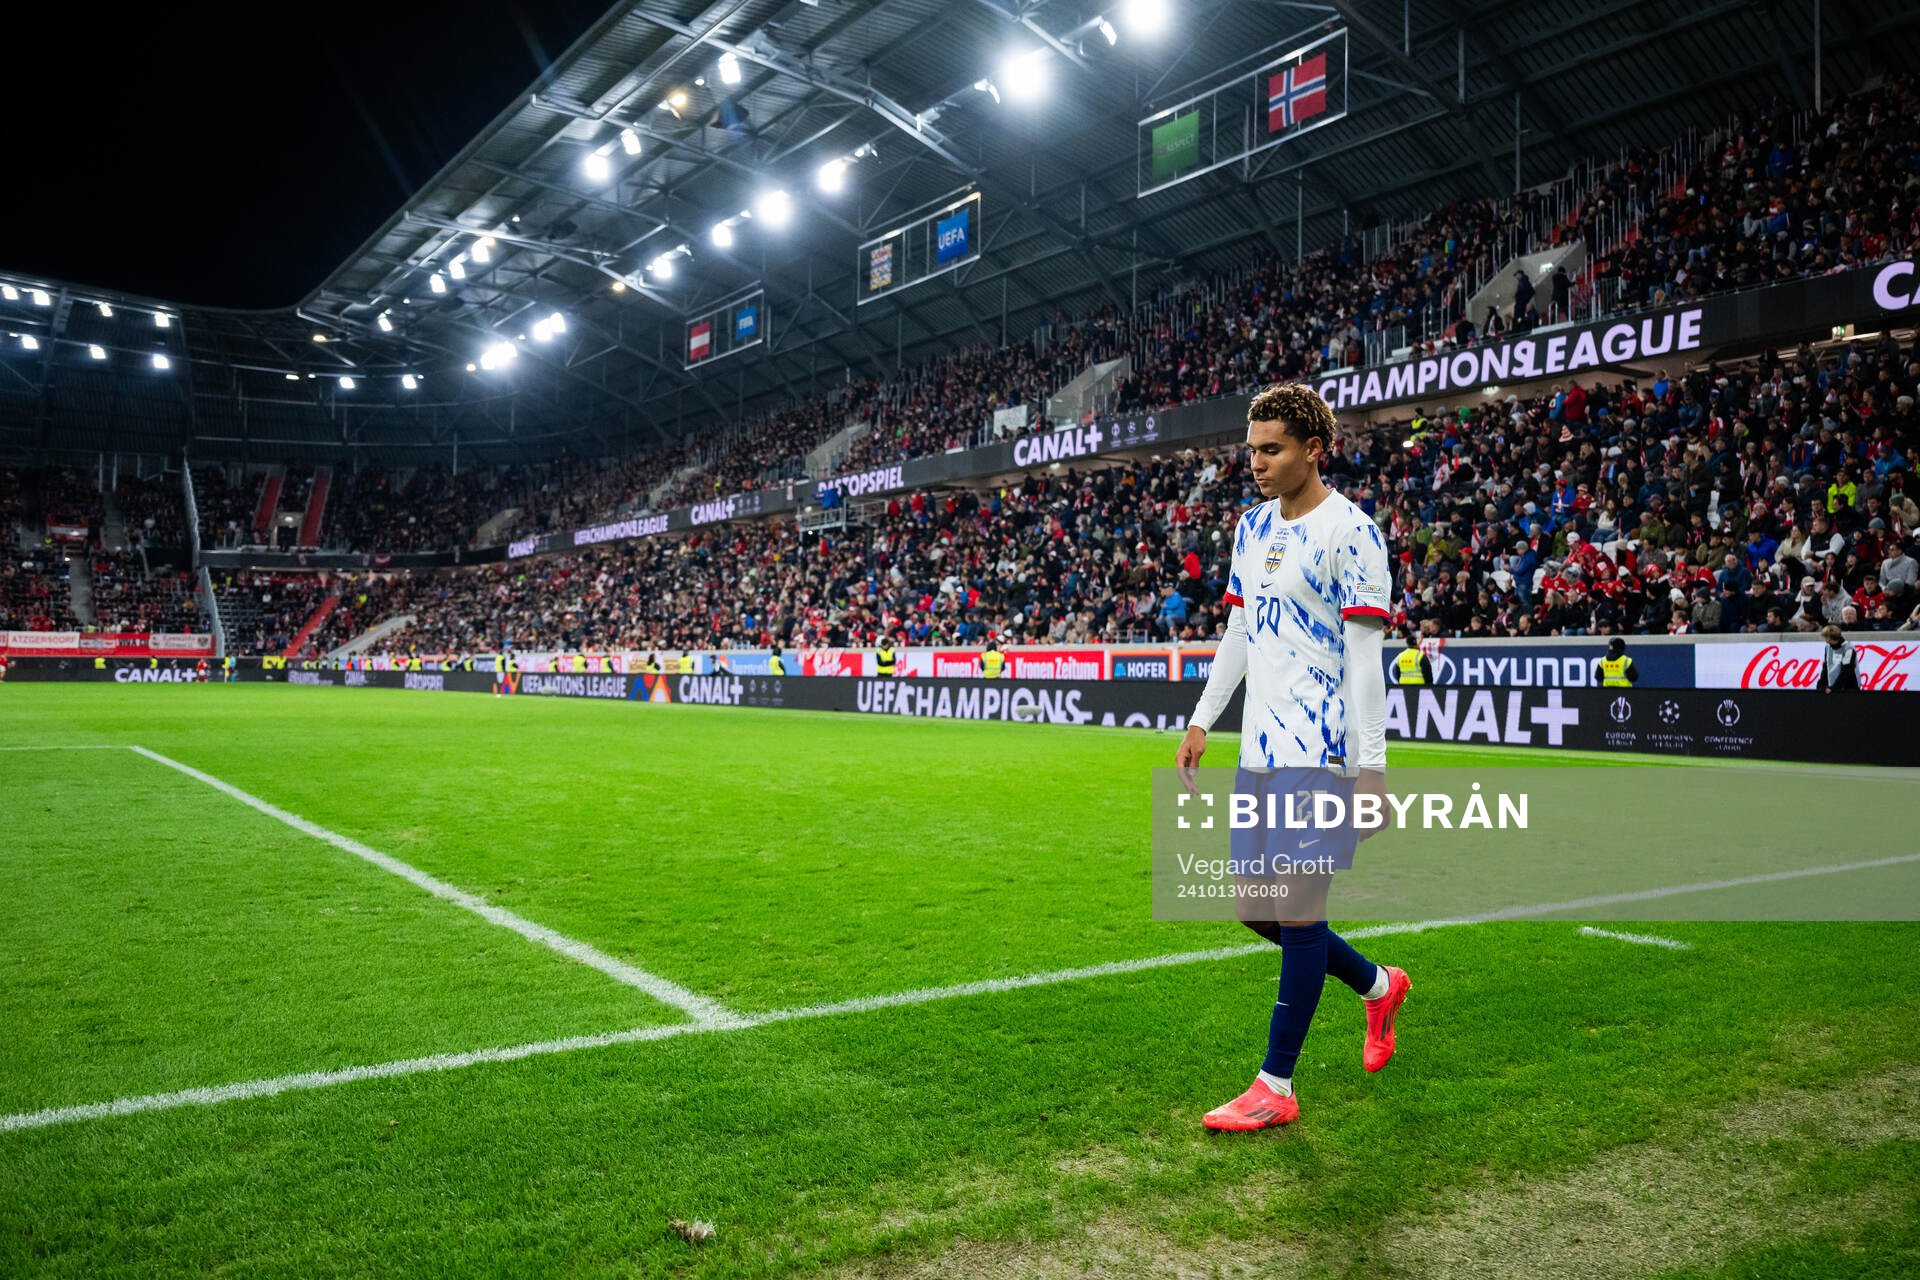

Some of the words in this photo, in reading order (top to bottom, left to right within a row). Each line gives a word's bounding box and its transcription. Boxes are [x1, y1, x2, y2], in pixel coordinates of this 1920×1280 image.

[938, 227, 966, 250] UEFA
[1319, 340, 1536, 410] CHAMPIONS
[1524, 309, 1703, 378] LEAGUE
[1014, 425, 1103, 467] CANAL+
[1256, 595, 1281, 637] 20
[114, 668, 197, 682] CANAL+
[937, 657, 972, 678] Kronen
[1016, 657, 1054, 680] Kronen
[1055, 656, 1099, 680] Zeitung
[1128, 661, 1167, 678] HOFER
[1463, 657, 1600, 687] HYUND
[522, 674, 543, 693] UEFA
[587, 677, 626, 698] LEAGUE
[679, 675, 743, 704] CANAL+
[1385, 689, 1579, 746] ANAL+
